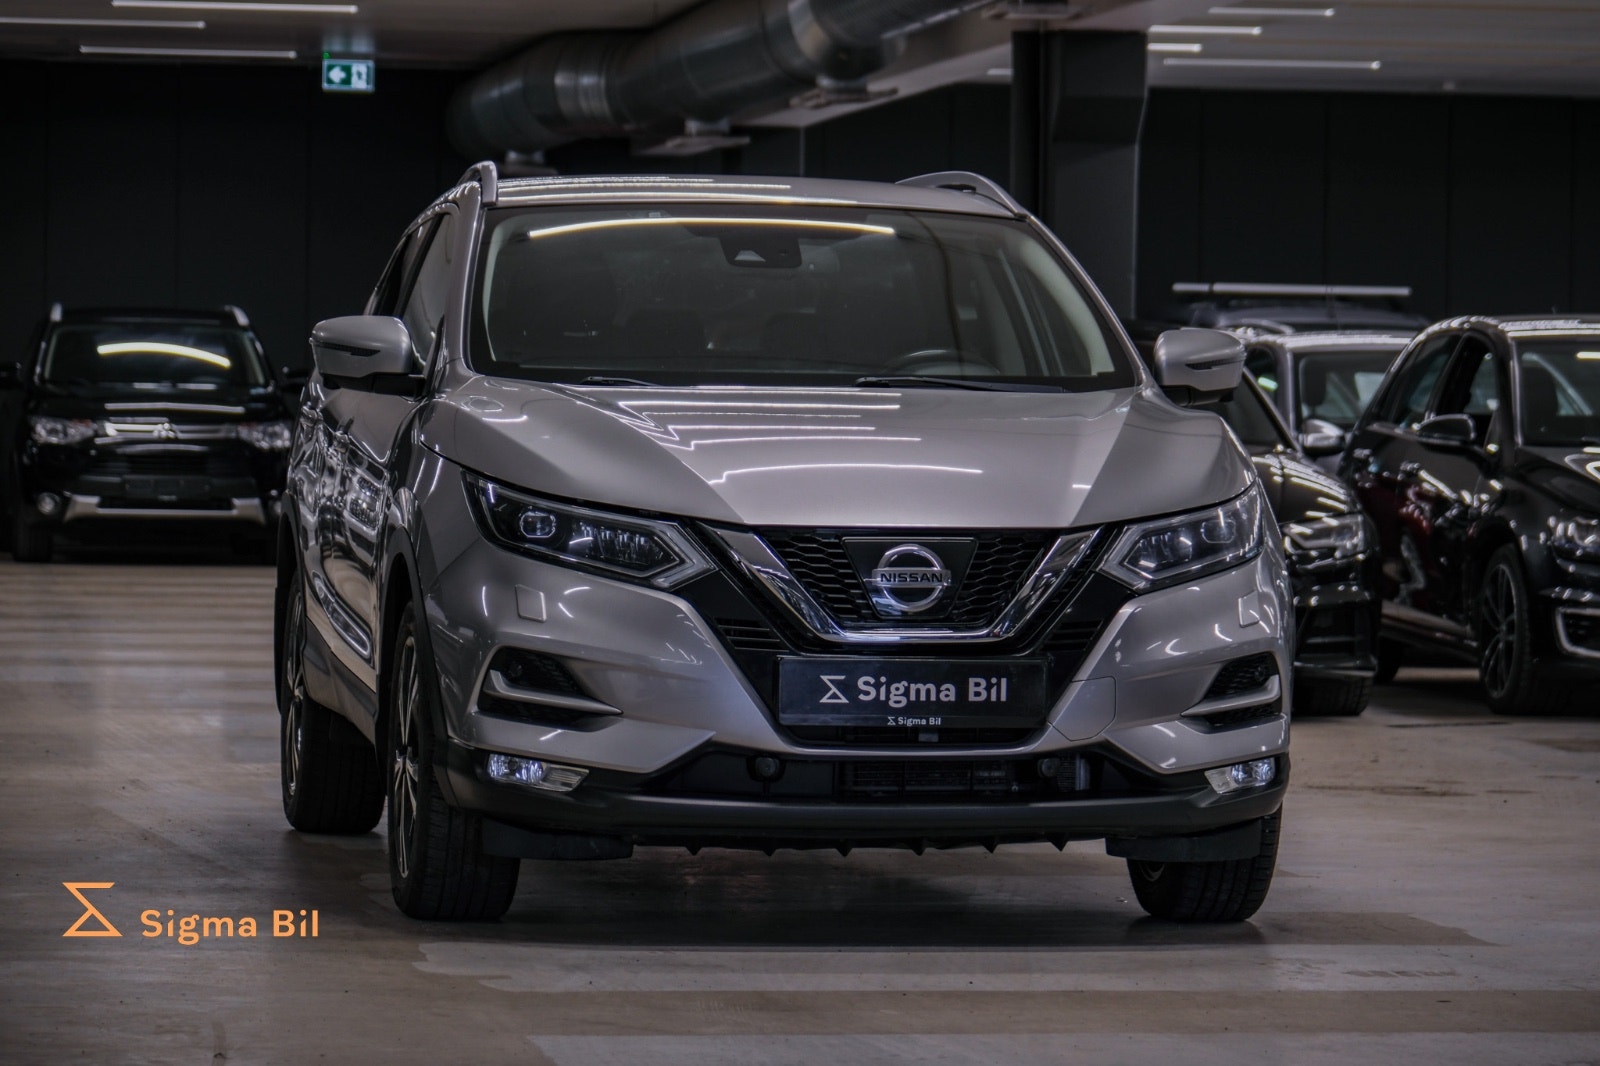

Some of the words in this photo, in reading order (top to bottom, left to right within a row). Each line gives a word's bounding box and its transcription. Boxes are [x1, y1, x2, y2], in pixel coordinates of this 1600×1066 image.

[879, 572, 943, 584] NISSAN
[857, 676, 956, 708] Sigma
[968, 677, 1007, 702] Bil
[897, 716, 926, 727] Sigma
[928, 716, 942, 726] Bil
